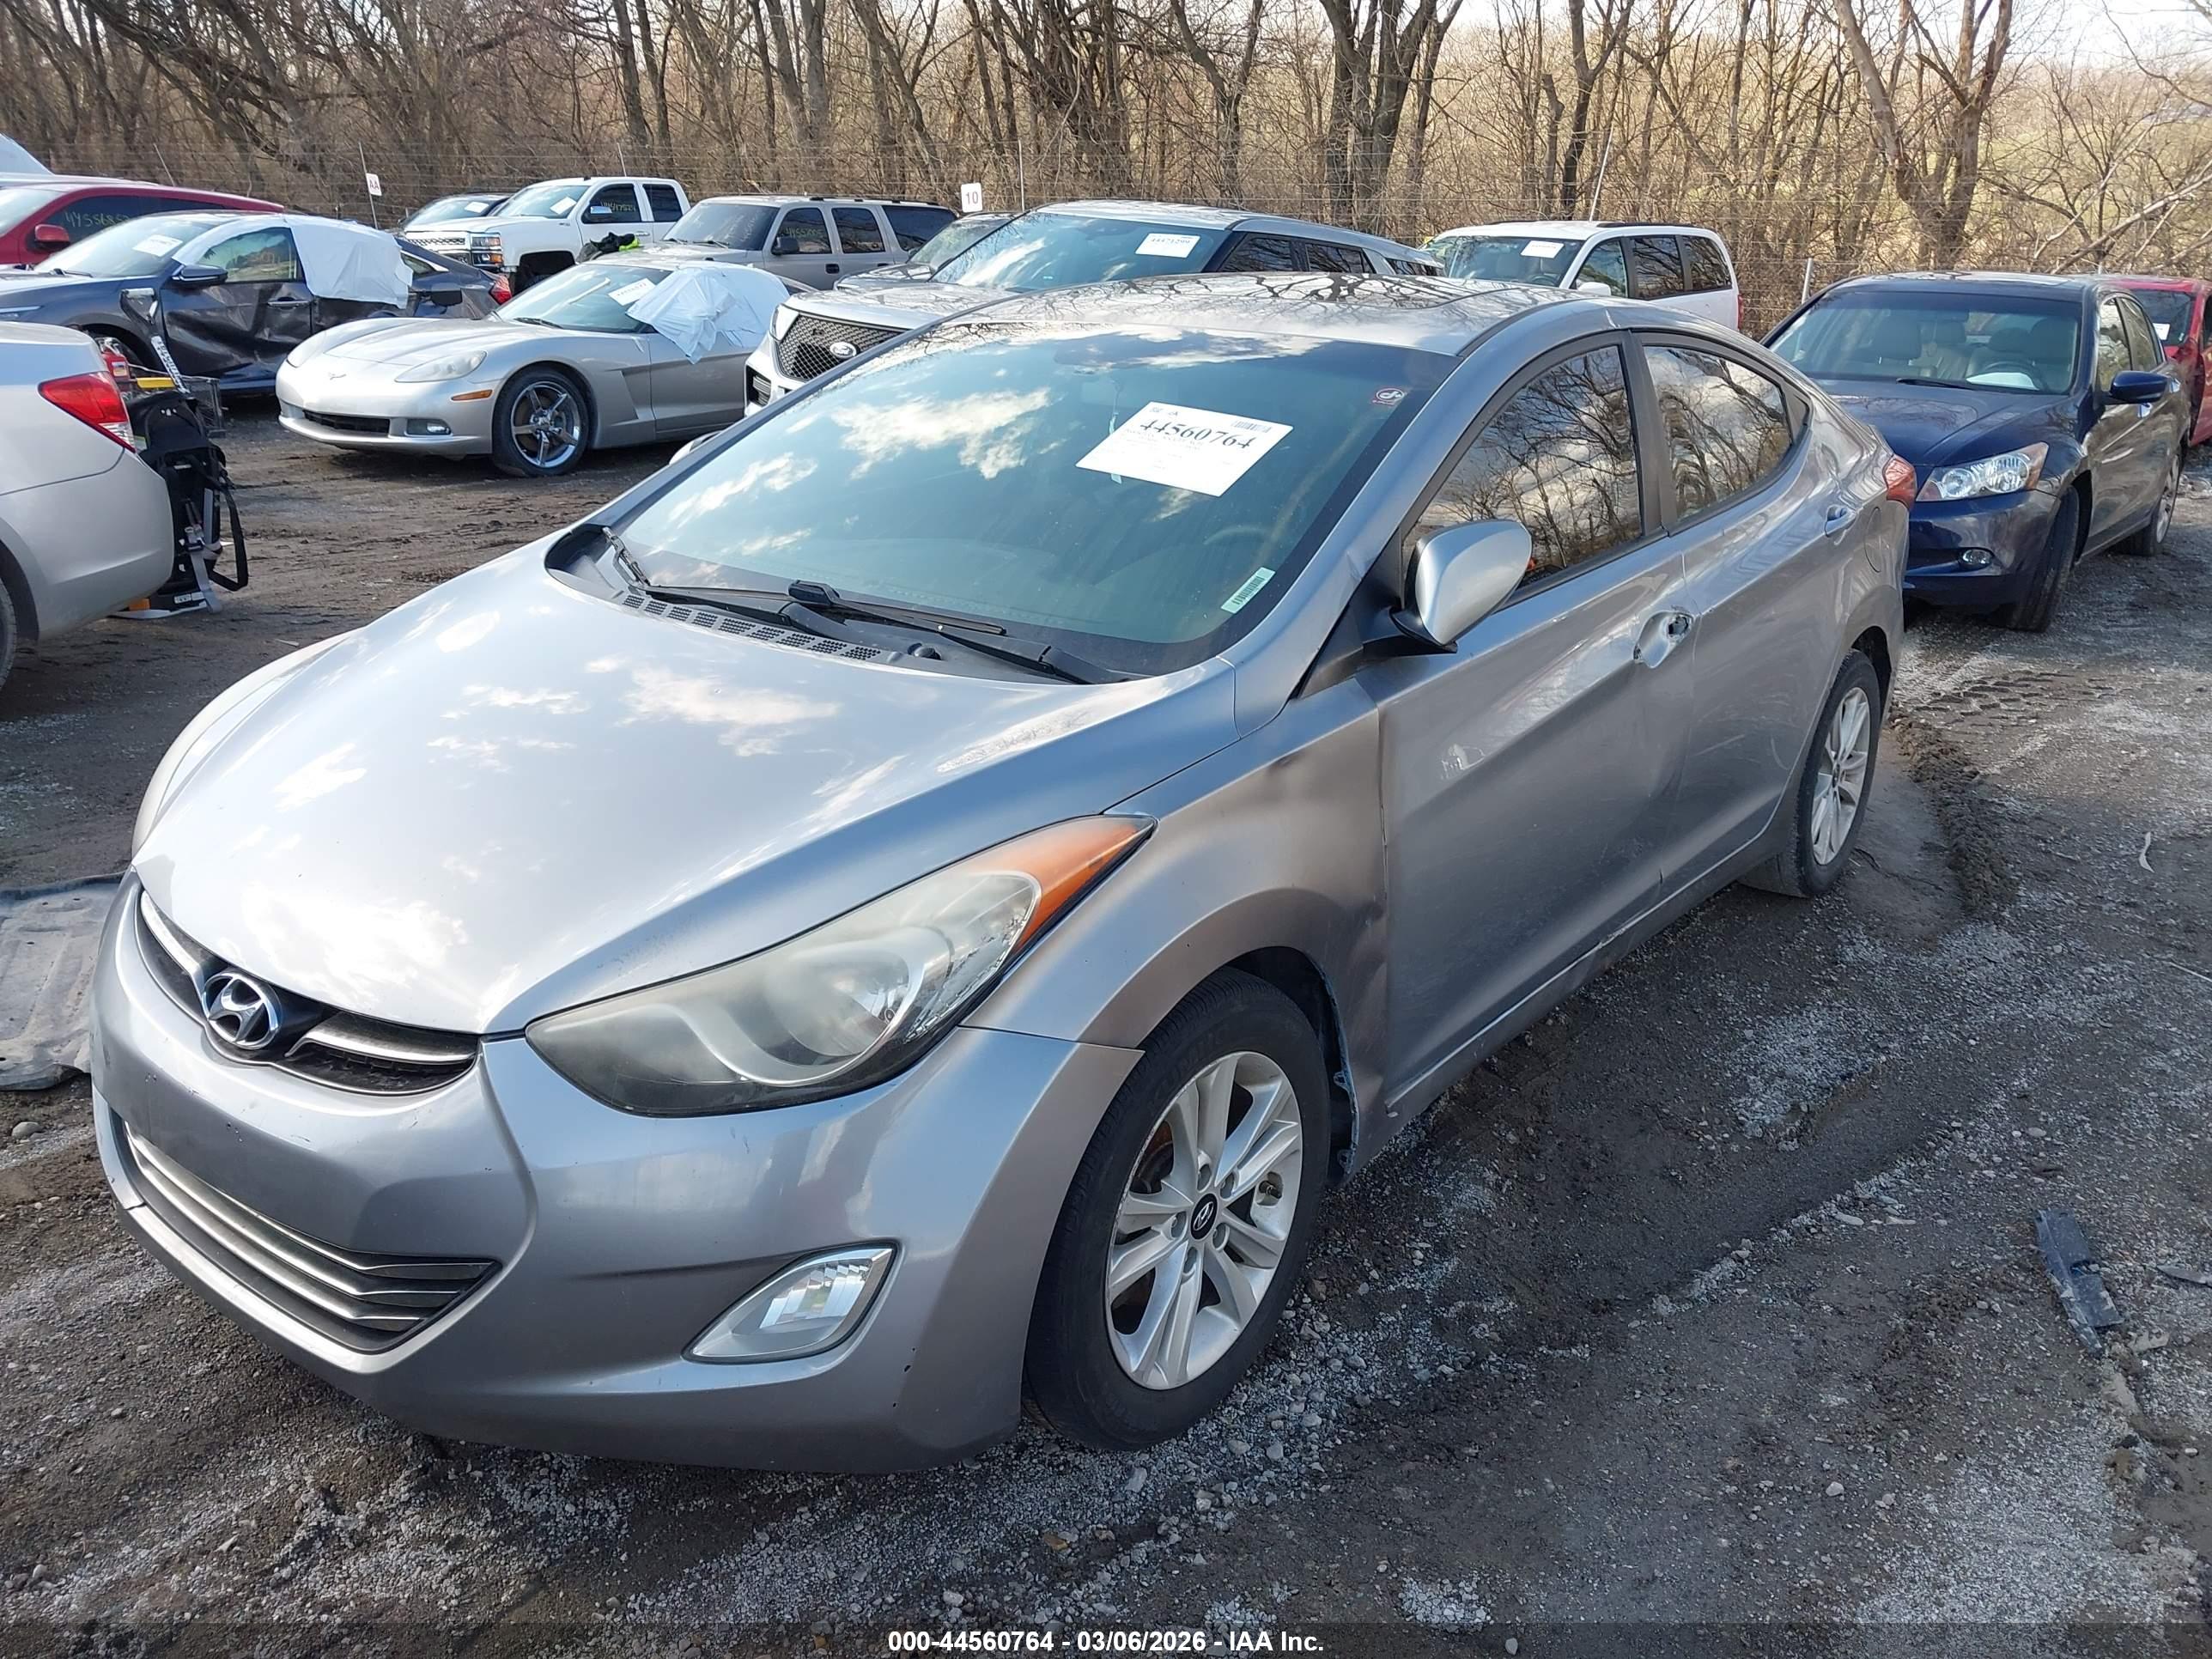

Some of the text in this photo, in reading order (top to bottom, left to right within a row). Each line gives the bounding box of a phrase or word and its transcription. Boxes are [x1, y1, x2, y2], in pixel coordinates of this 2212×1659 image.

[368, 178, 380, 191] AA
[965, 191, 979, 205] 10
[1139, 418, 1257, 450] 44560764
